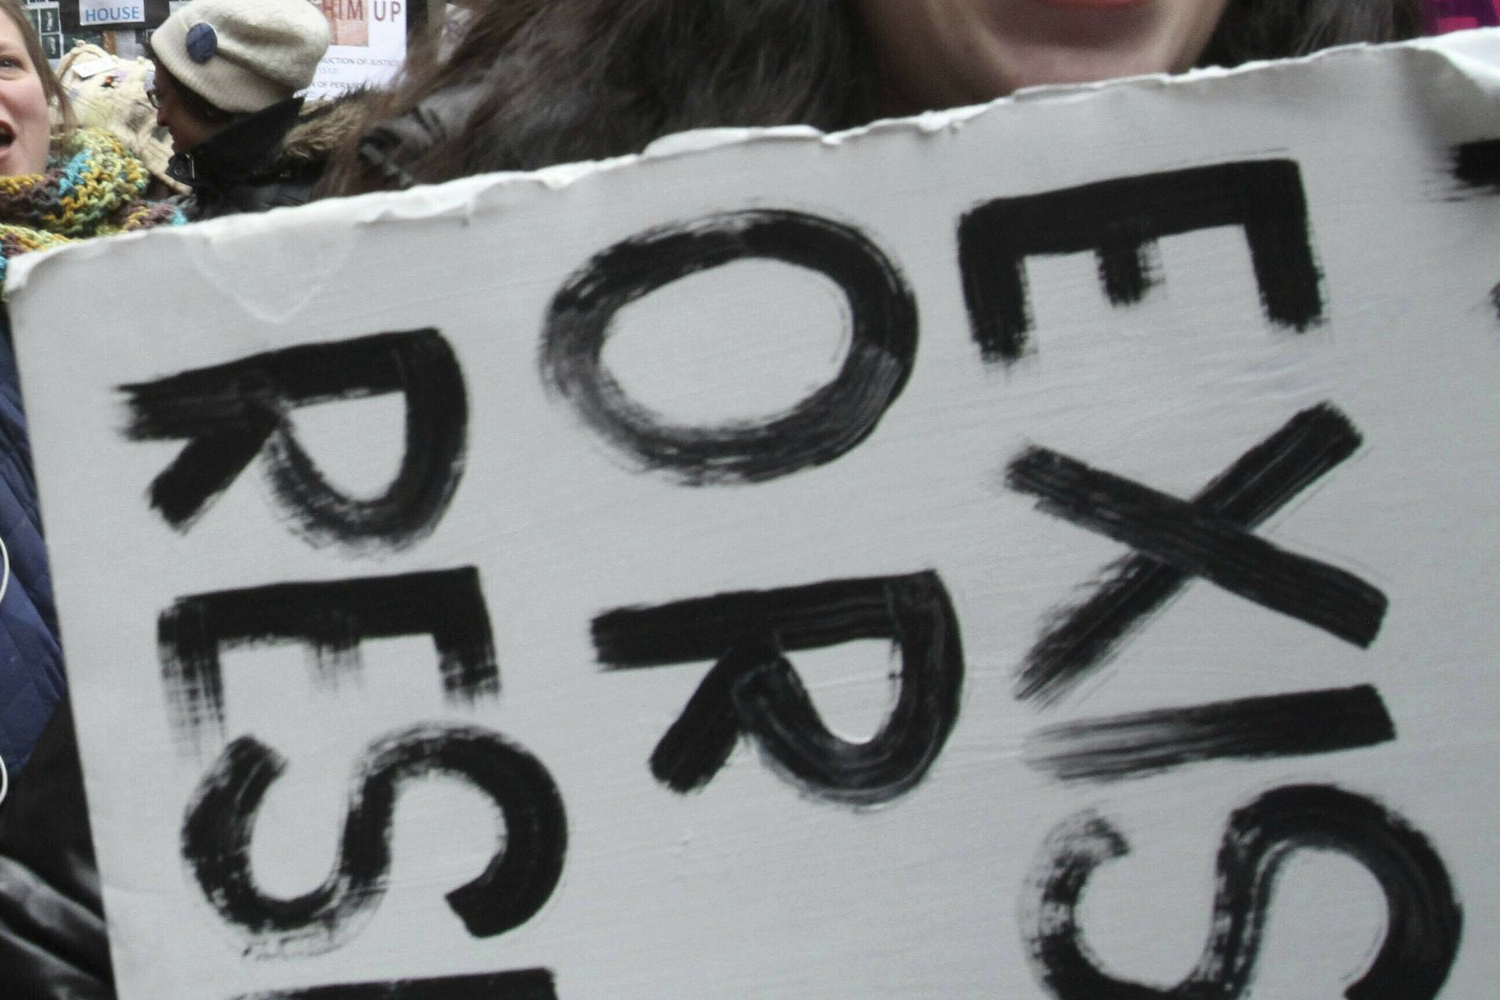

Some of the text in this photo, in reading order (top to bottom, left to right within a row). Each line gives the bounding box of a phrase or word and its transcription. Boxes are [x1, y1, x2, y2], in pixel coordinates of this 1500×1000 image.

[85, 6, 140, 22] HOUSE
[373, 0, 402, 22] UP
[540, 206, 965, 807] OR
